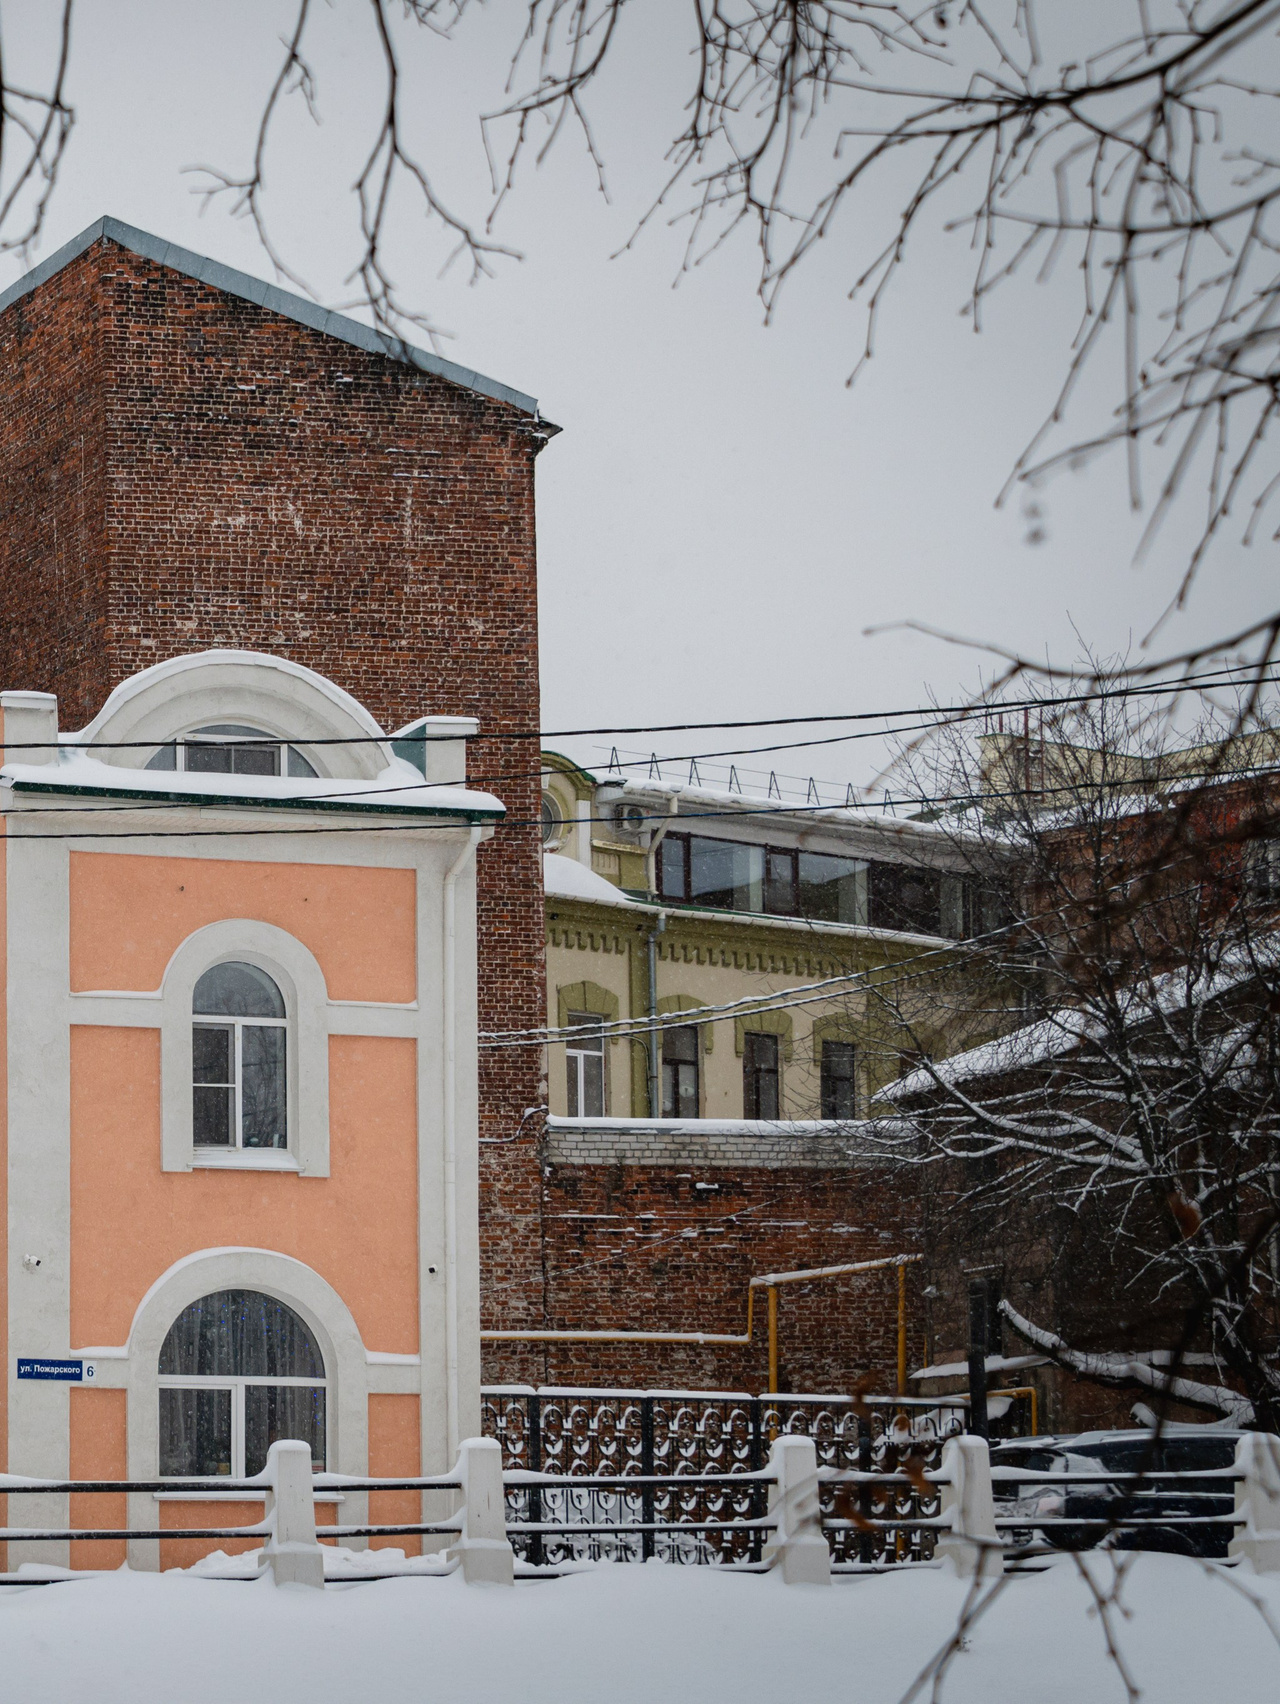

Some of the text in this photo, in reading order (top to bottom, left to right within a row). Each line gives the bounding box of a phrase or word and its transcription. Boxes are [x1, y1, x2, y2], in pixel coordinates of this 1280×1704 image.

[20, 1365, 94, 1377] ул. Пожарского 6
